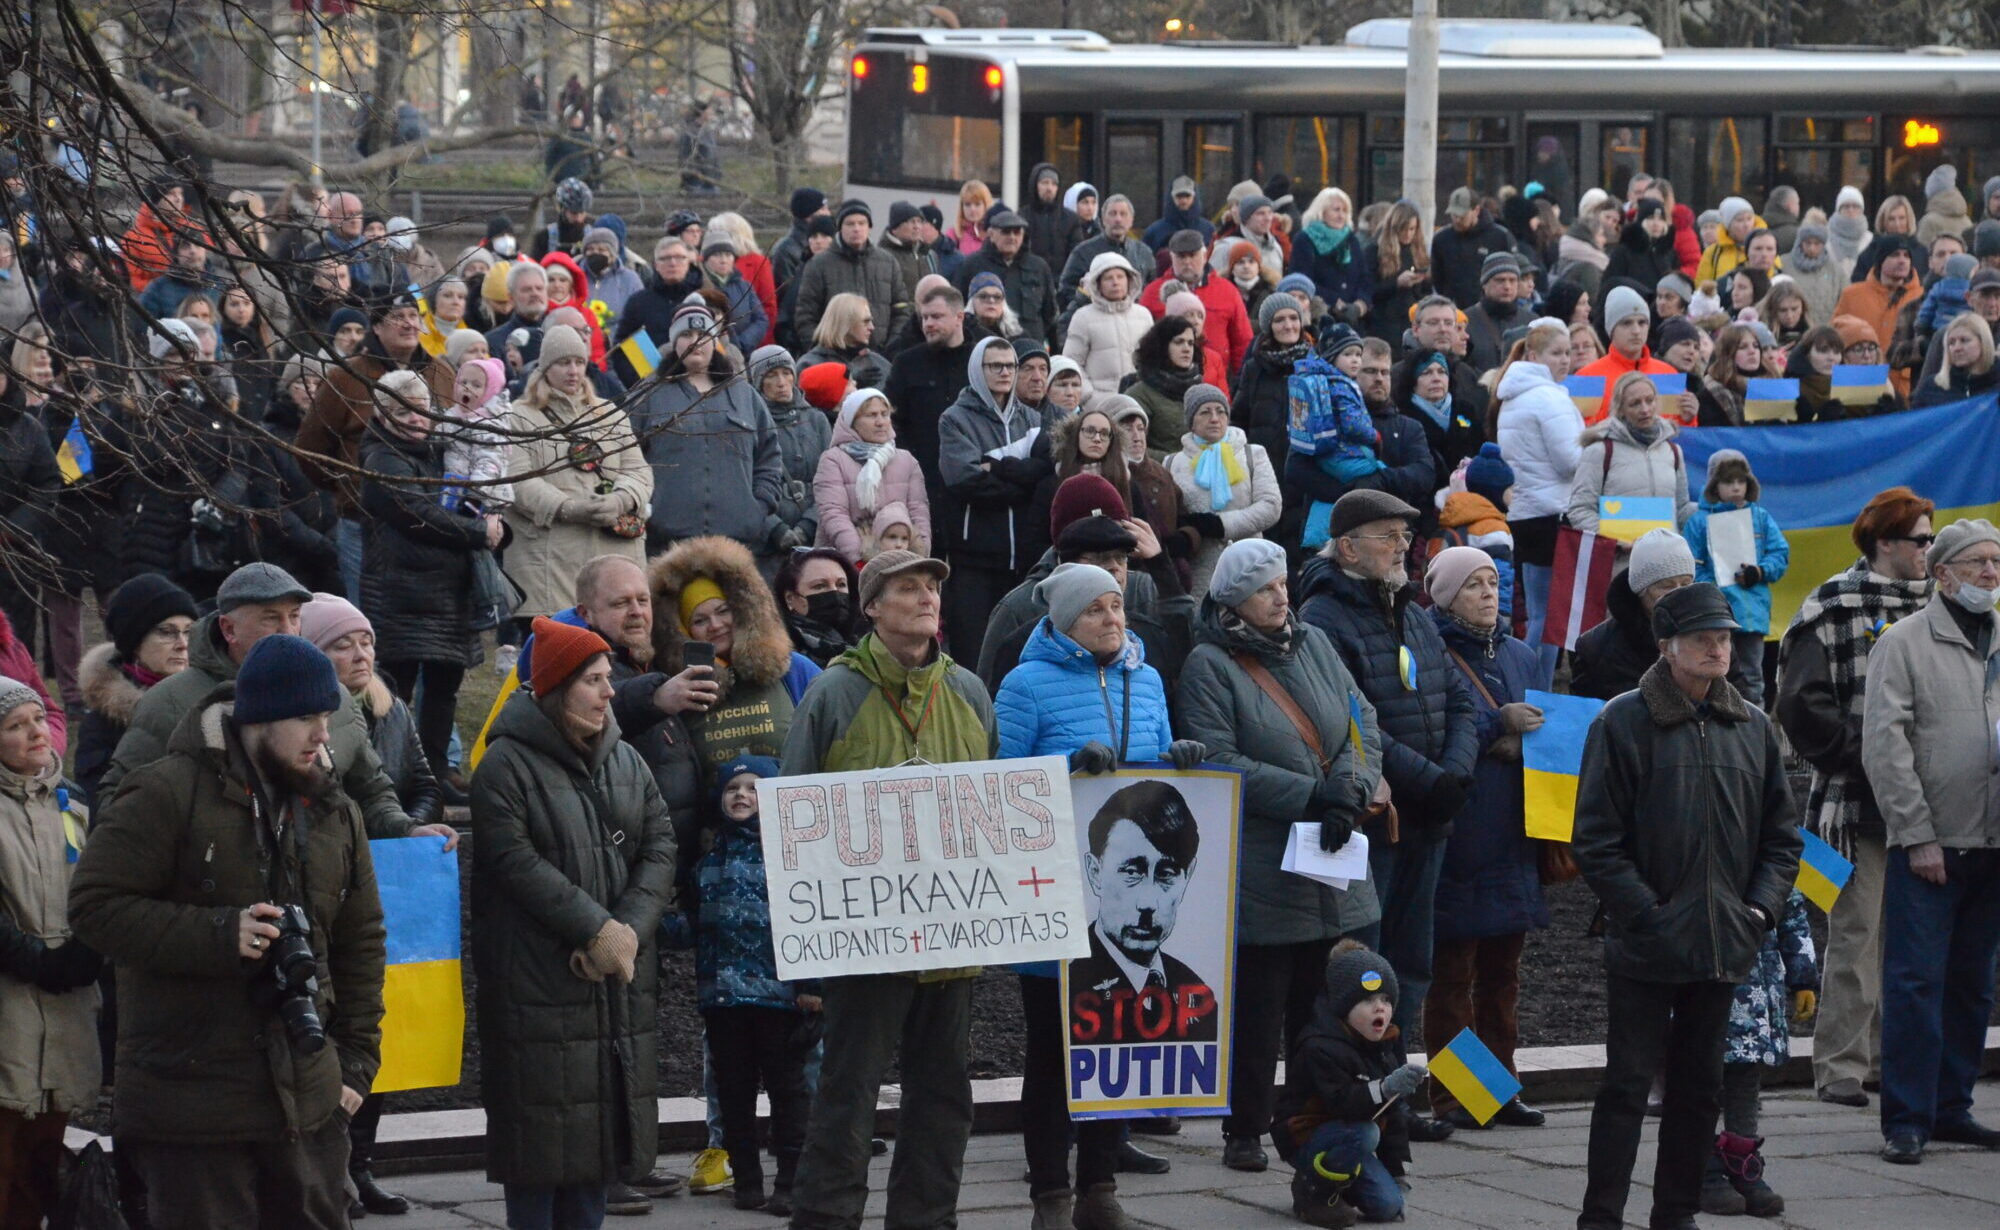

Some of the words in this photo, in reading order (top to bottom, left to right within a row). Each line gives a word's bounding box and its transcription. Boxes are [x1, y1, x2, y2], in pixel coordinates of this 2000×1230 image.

[704, 718, 775, 743] военный
[776, 768, 1055, 870] PUTINS
[789, 867, 1008, 924] SLEPKAVA
[781, 926, 908, 964] OKUPANTS
[923, 911, 1069, 951] IZVAROTĀJS
[1072, 984, 1216, 1041] STOP
[1070, 1045, 1217, 1099] PUTIN
